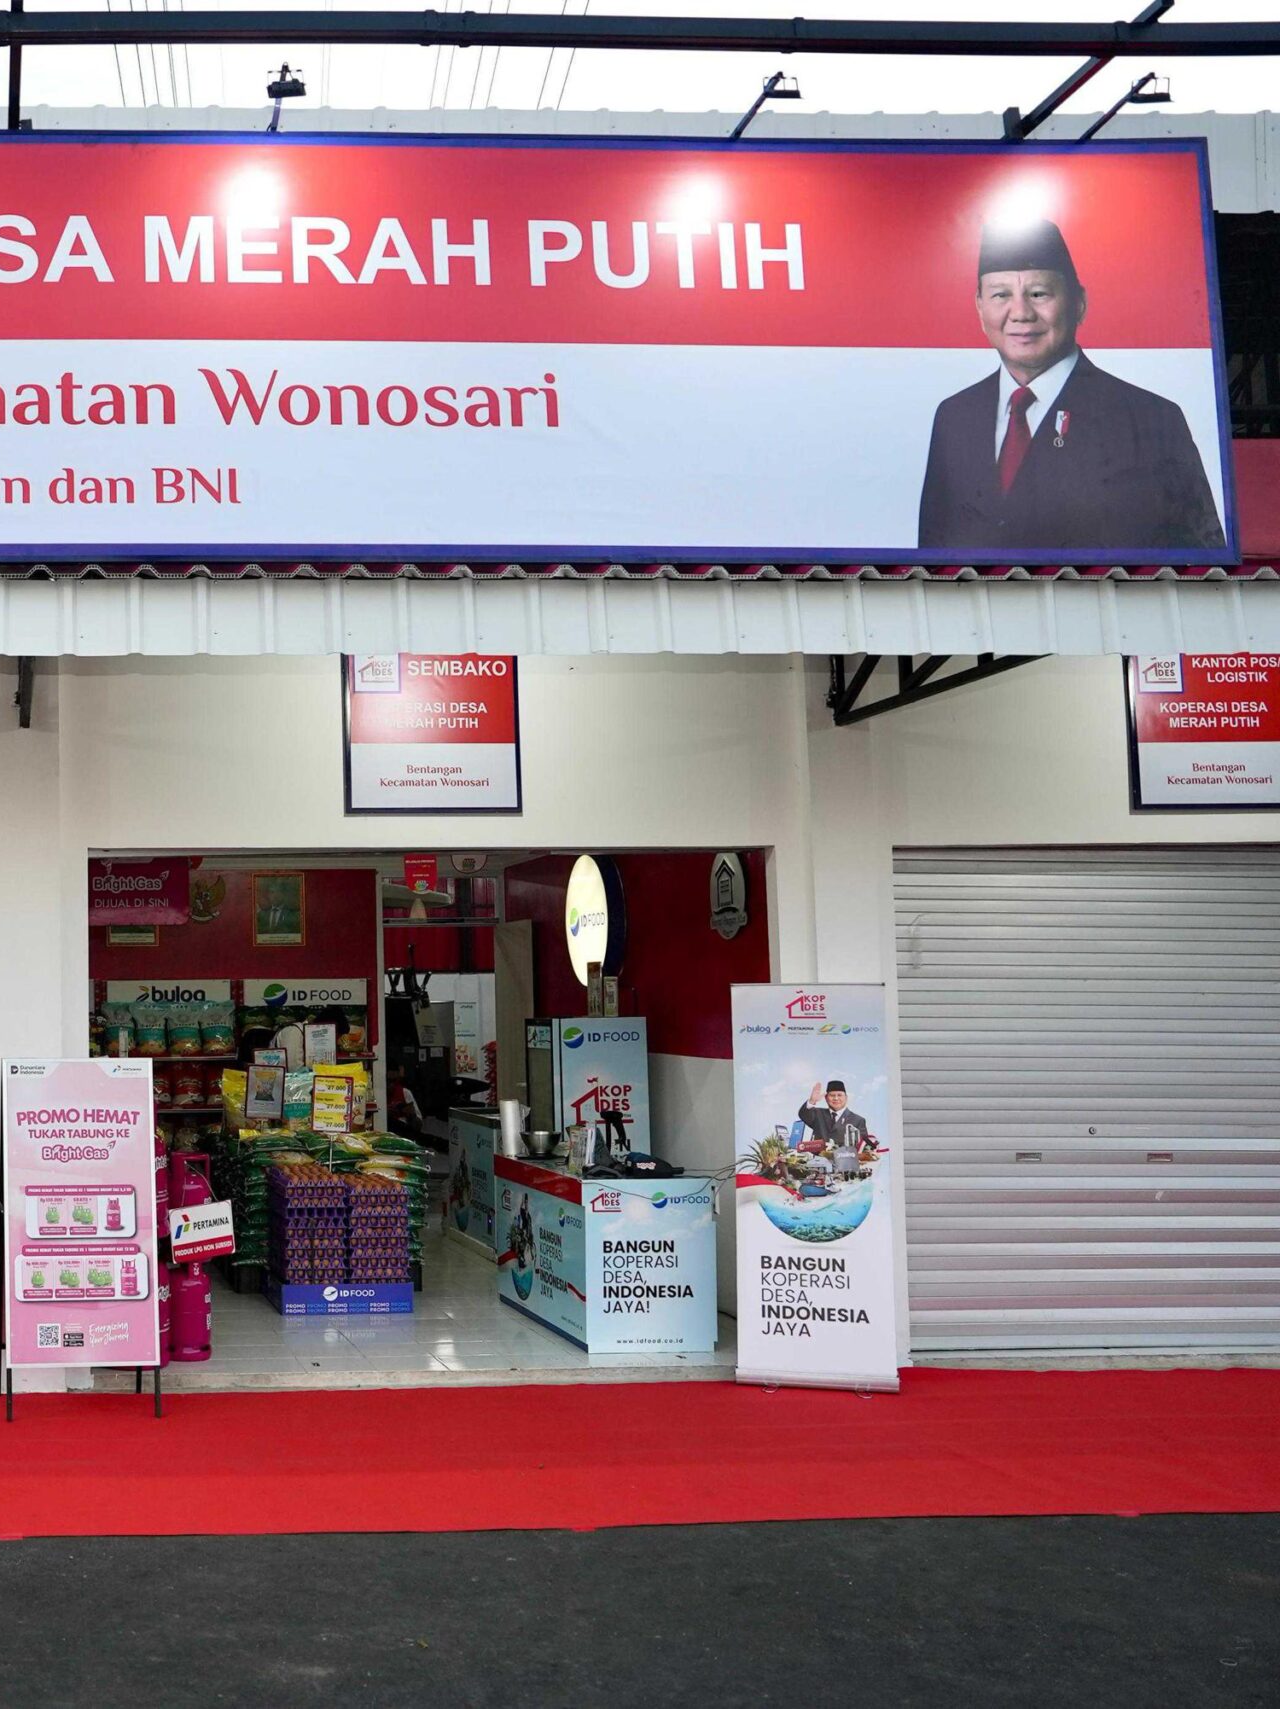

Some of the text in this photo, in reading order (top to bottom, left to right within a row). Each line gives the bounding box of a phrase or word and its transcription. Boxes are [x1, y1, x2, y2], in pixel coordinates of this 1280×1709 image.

[144, 215, 491, 286] MERAH
[528, 220, 805, 291] PUTIH
[198, 367, 559, 428] Wonosari
[48, 467, 135, 505] dan
[151, 467, 241, 505] BNI
[407, 660, 507, 677] SEMBAKO
[1192, 657, 1247, 668] KANTOR
[374, 668, 392, 676] DES
[1157, 669, 1176, 677] DES
[1207, 671, 1268, 682] LOGISTIK
[449, 702, 487, 713] DESA
[1159, 701, 1268, 713] KOPERASI DESA
[438, 717, 478, 728] PUTIH
[1169, 716, 1260, 728] MERAH PUTIH
[406, 765, 462, 775] Bentangan
[1192, 763, 1246, 773] Bentangan
[379, 777, 489, 787] Kecamatan Wonosari
[1167, 774, 1273, 785] Kecamatan Wonosari
[92, 875, 162, 893] Bright Gas
[94, 898, 169, 908] DIJUAL DI SINI
[292, 989, 352, 1001] ID FOOD
[804, 995, 826, 1003] KOP
[804, 1003, 825, 1011] DES
[747, 1025, 771, 1034] bulog
[587, 1031, 640, 1042] ID FOOD
[599, 1085, 632, 1097] KOP
[600, 1098, 630, 1111] DES
[16, 1108, 140, 1126] PROMO HEMAT
[28, 1128, 130, 1139] TUKAR TABUNG KE
[42, 1145, 109, 1162] Bright Gas
[670, 1196, 710, 1204] ID FOOD
[193, 1216, 229, 1231] PERTAMINA
[539, 1227, 562, 1247] BANGUN
[539, 1242, 563, 1262] KOPERASI
[603, 1240, 675, 1253] BANGUN
[603, 1255, 678, 1268] KOPERASI
[760, 1256, 845, 1273] BANGUN
[539, 1271, 568, 1294] INDONESIA
[603, 1270, 647, 1286] DESA,
[761, 1272, 850, 1289] KOPERASI
[603, 1285, 694, 1299] INDONESIA
[761, 1288, 813, 1307] DESA,
[603, 1301, 650, 1313] JAYA!
[761, 1305, 870, 1324] INDONESIA
[762, 1322, 811, 1337] JAYA
